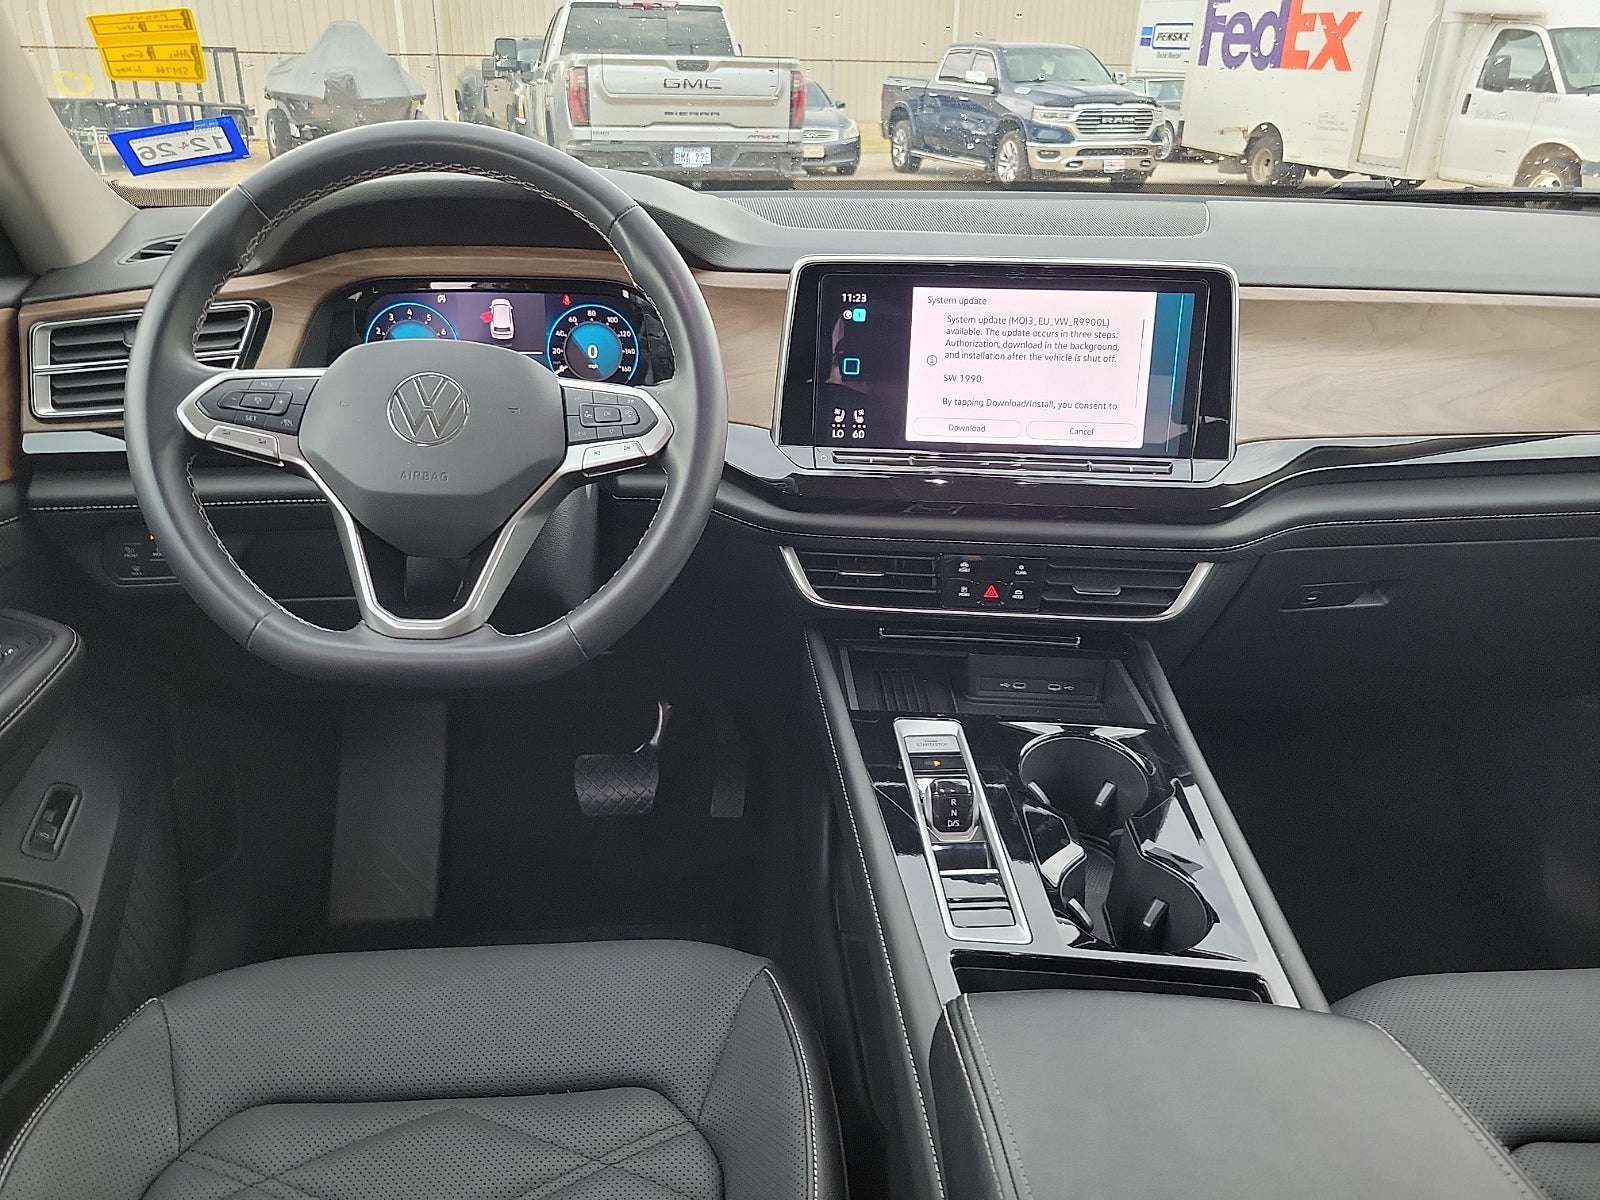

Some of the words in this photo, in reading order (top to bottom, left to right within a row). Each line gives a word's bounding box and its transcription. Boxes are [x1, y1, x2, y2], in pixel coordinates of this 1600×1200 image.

[1156, 32, 1191, 42] PENSKE
[1197, 0, 1363, 72] FedEx
[663, 77, 723, 90] GMC
[841, 293, 867, 303] 11:23
[927, 295, 957, 306] System
[958, 297, 988, 307] update
[407, 308, 413, 316] 4
[426, 314, 432, 322] 5
[946, 314, 976, 325] System
[978, 315, 1007, 325] update
[376, 326, 381, 335] 2
[441, 328, 447, 336] 6
[946, 327, 983, 336] available.
[985, 328, 1000, 336] The
[1002, 328, 1030, 338] update
[1032, 330, 1059, 338] occurs
[1060, 330, 1069, 338] in
[1070, 330, 1092, 338] three
[1094, 331, 1119, 340] steps:
[945, 339, 1000, 349] Authorization,
[1002, 340, 1043, 350] download
[1044, 341, 1052, 350] in
[1054, 341, 1068, 350] the
[1070, 342, 1120, 352] background,
[587, 344, 598, 359] 0
[944, 351, 960, 359] and
[961, 351, 1006, 360] installation
[1006, 352, 1027, 360] after
[1029, 352, 1043, 361] the
[1044, 354, 1073, 362] vehicle
[1074, 354, 1081, 362] is
[1082, 354, 1102, 362] shut
[1102, 354, 1117, 363] off.
[943, 374, 958, 382] SW
[960, 374, 982, 383] 1990
[942, 397, 953, 407] By
[954, 398, 984, 408] tapping
[986, 398, 1056, 410] Download/Install,
[1057, 401, 1073, 410] you
[1074, 402, 1107, 410] consent
[1108, 402, 1118, 410] to
[245, 414, 257, 422] SET
[948, 424, 986, 433] Download
[1069, 427, 1094, 436] Cancel
[832, 429, 845, 438] LO
[852, 430, 865, 439] 60
[400, 470, 449, 482] AIRBAG
[950, 798, 957, 806] R
[950, 809, 958, 817] N
